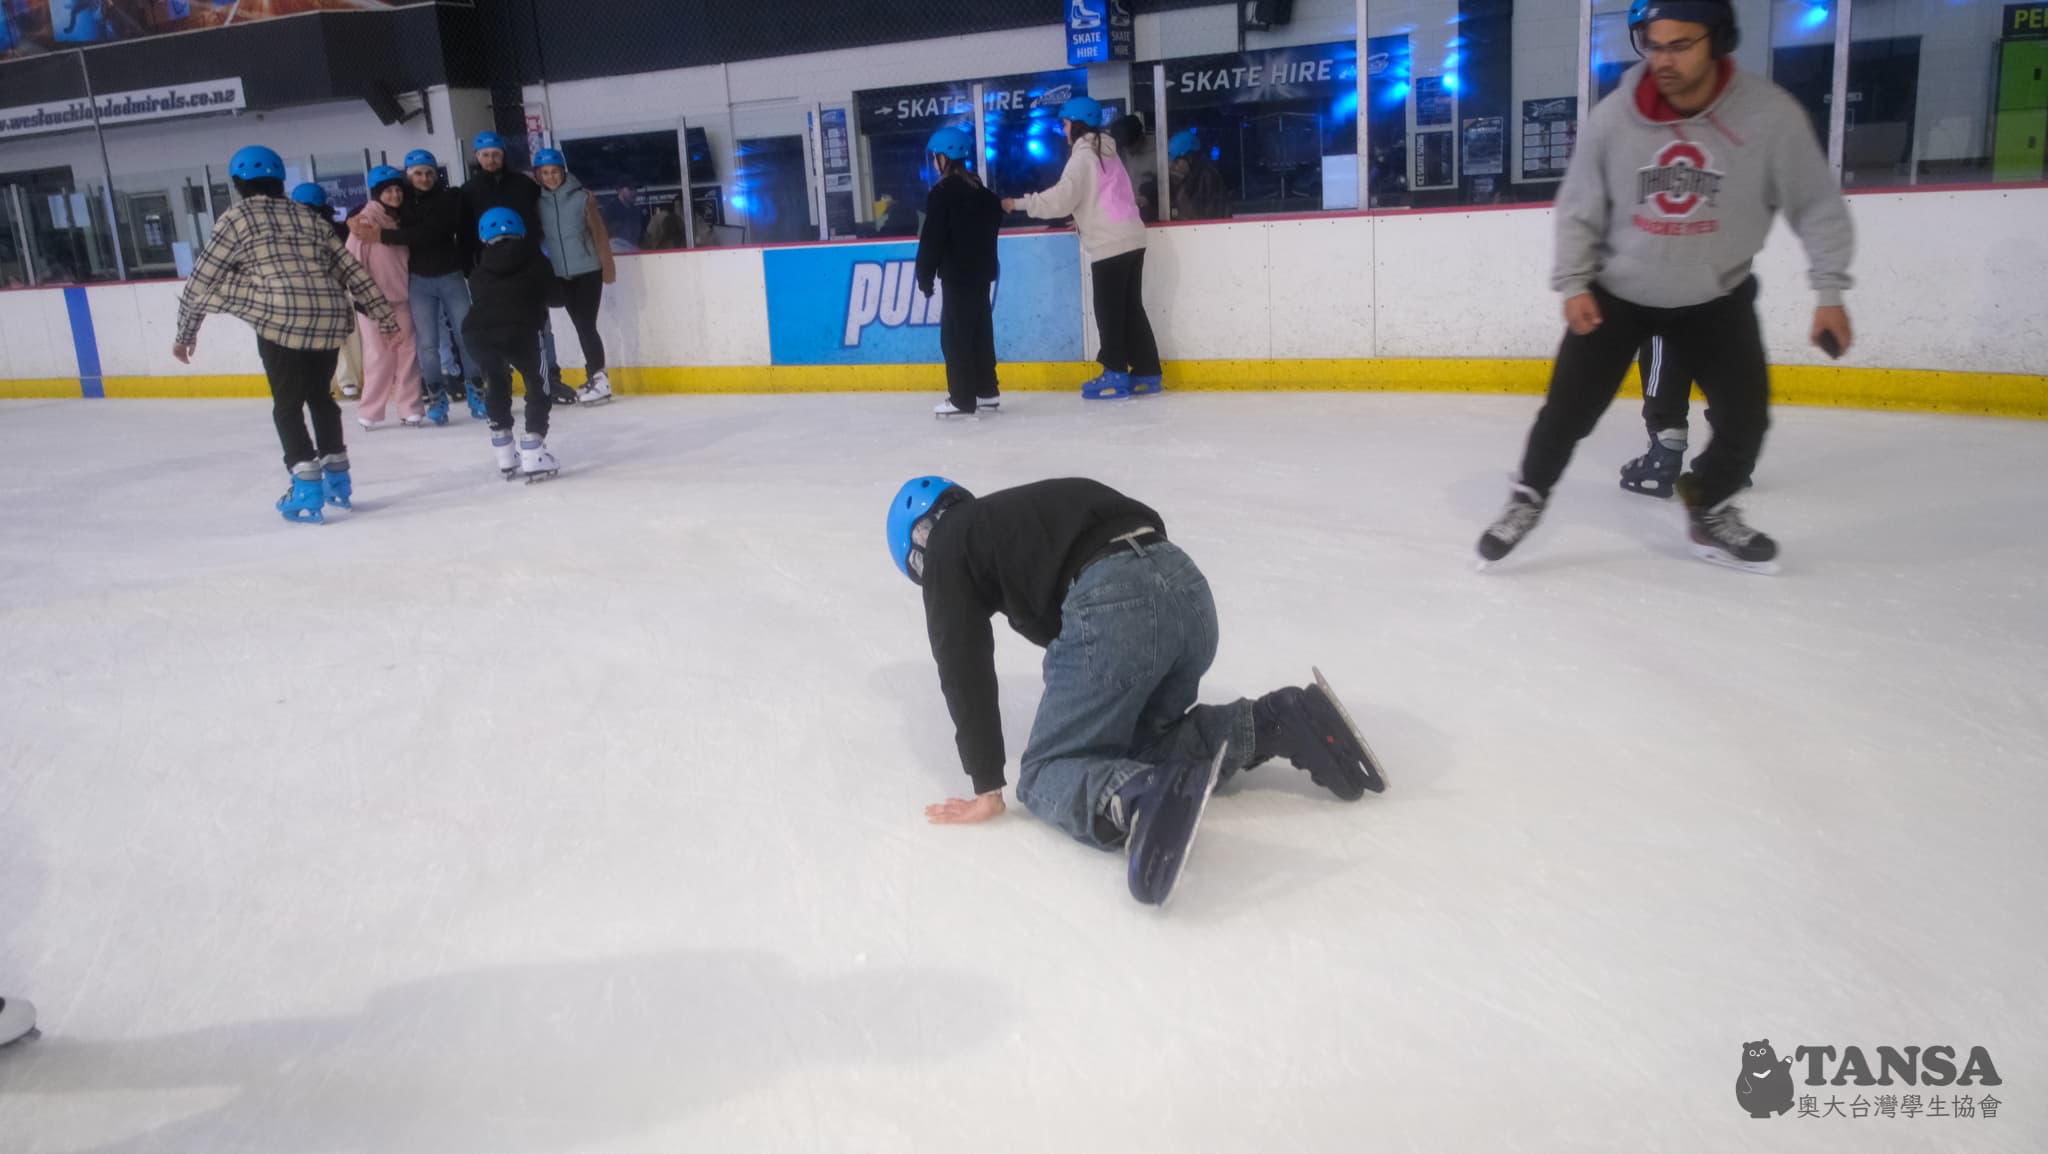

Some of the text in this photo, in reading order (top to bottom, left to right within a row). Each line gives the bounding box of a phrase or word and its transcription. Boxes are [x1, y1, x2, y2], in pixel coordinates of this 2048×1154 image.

[2014, 8, 2048, 29] PE
[1072, 31, 1101, 45] SKATE
[1076, 46, 1099, 58] HIRE
[1180, 65, 1263, 93] SKATE
[1270, 58, 1334, 86] HIRE
[897, 95, 966, 119] SKATE
